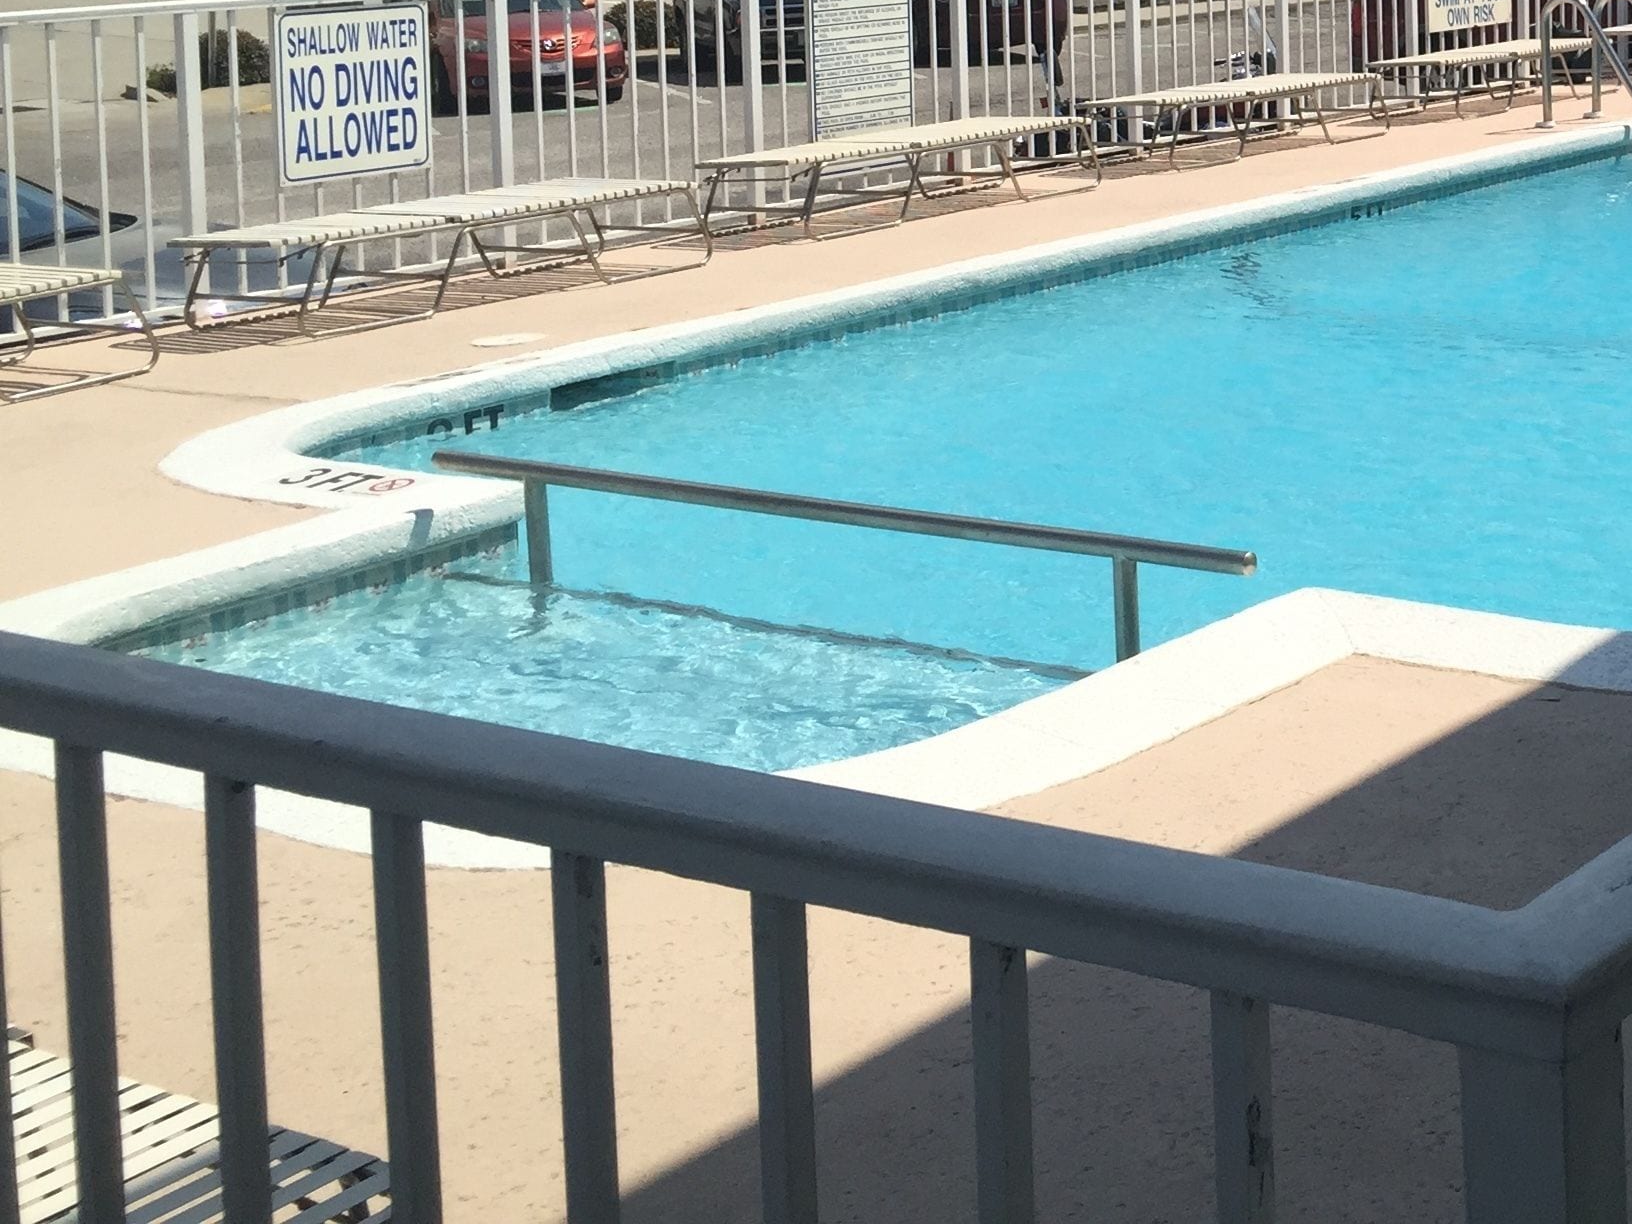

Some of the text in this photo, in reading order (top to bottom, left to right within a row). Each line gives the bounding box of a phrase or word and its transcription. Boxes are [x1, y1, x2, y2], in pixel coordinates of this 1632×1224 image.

[1447, 4, 1495, 26] OWN RISK
[287, 18, 417, 58] SHALLOW WATER
[289, 56, 418, 112] NO DIVING
[296, 107, 418, 164] ALLOWED
[464, 404, 504, 435] FT
[279, 468, 332, 484] 3
